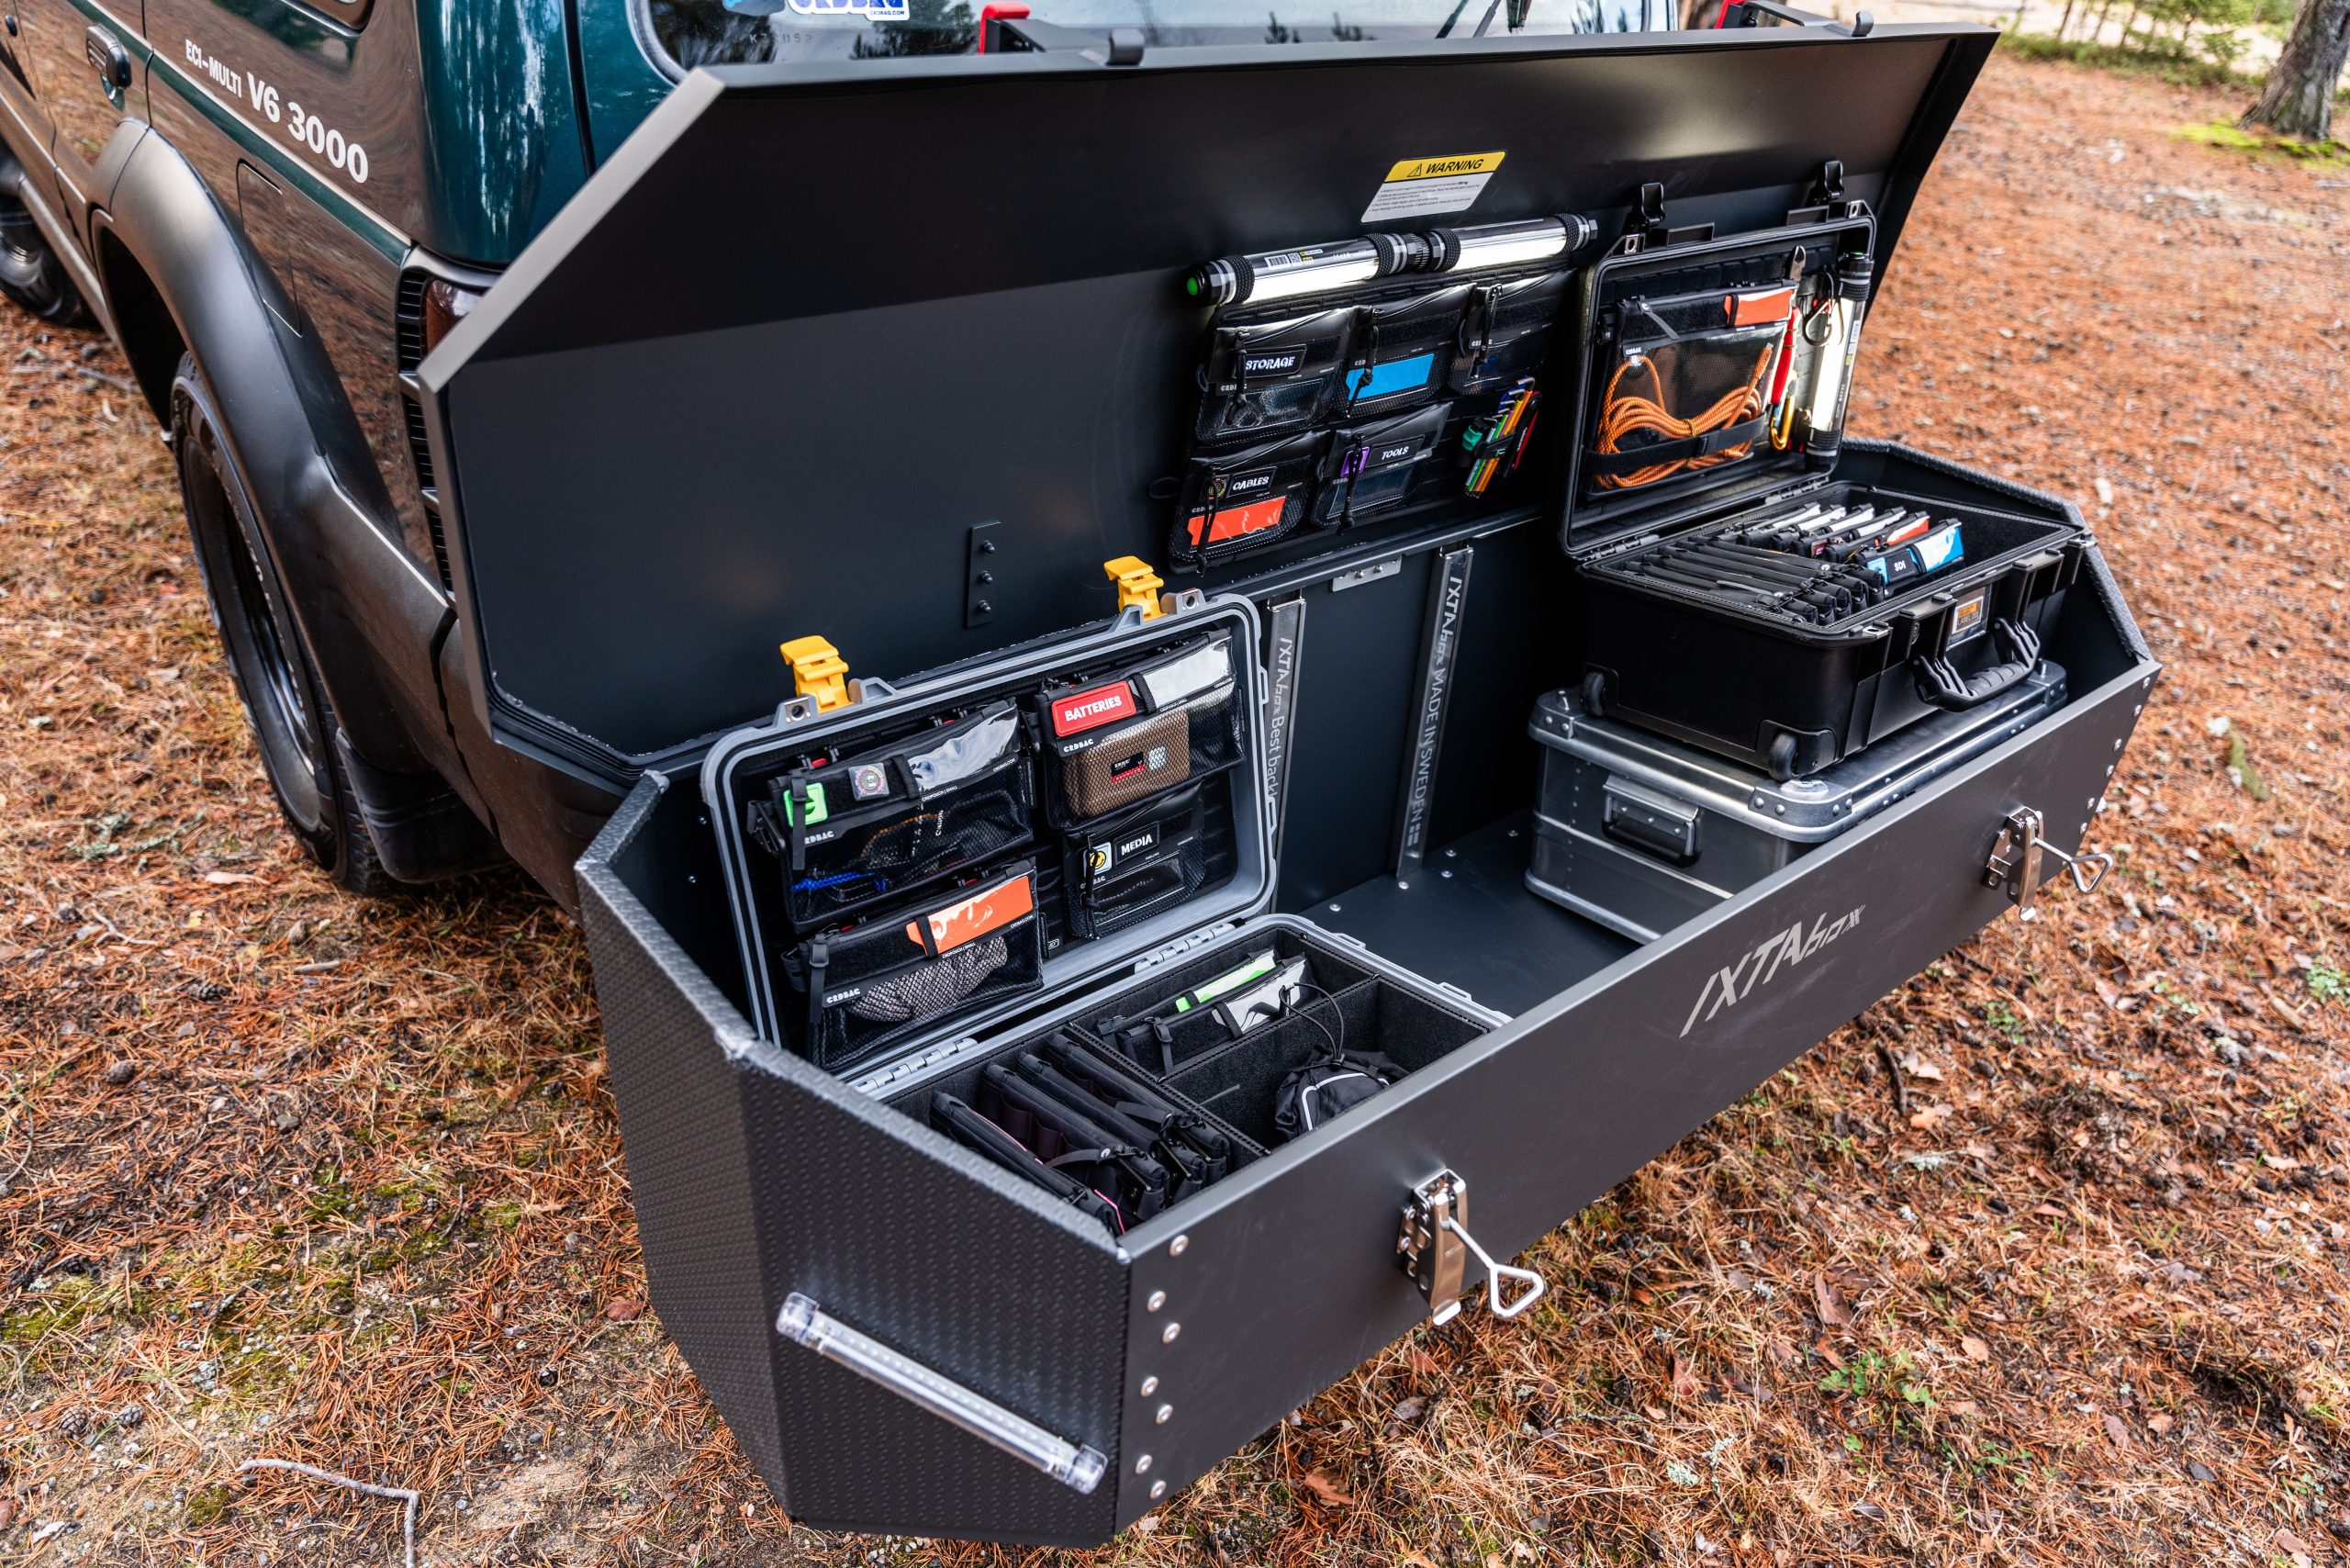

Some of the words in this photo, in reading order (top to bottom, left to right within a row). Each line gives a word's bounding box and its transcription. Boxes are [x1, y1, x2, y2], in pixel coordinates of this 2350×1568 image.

[185, 39, 241, 98] ECI-MULTI
[247, 71, 280, 123] V6
[287, 101, 368, 184] 3000
[1426, 159, 1484, 174] WARNING
[1246, 356, 1295, 371] STORAGE
[1382, 446, 1410, 460] TOOLS
[1232, 476, 1270, 491] CABLES
[1894, 560, 1907, 572] SDI
[1426, 667, 1447, 724] MADE
[1064, 695, 1123, 722] BATTERIES
[1269, 715, 1285, 755] Best
[1423, 725, 1437, 746] IN
[1410, 747, 1433, 823] SWEDEN
[1121, 834, 1153, 856] MEDIA
